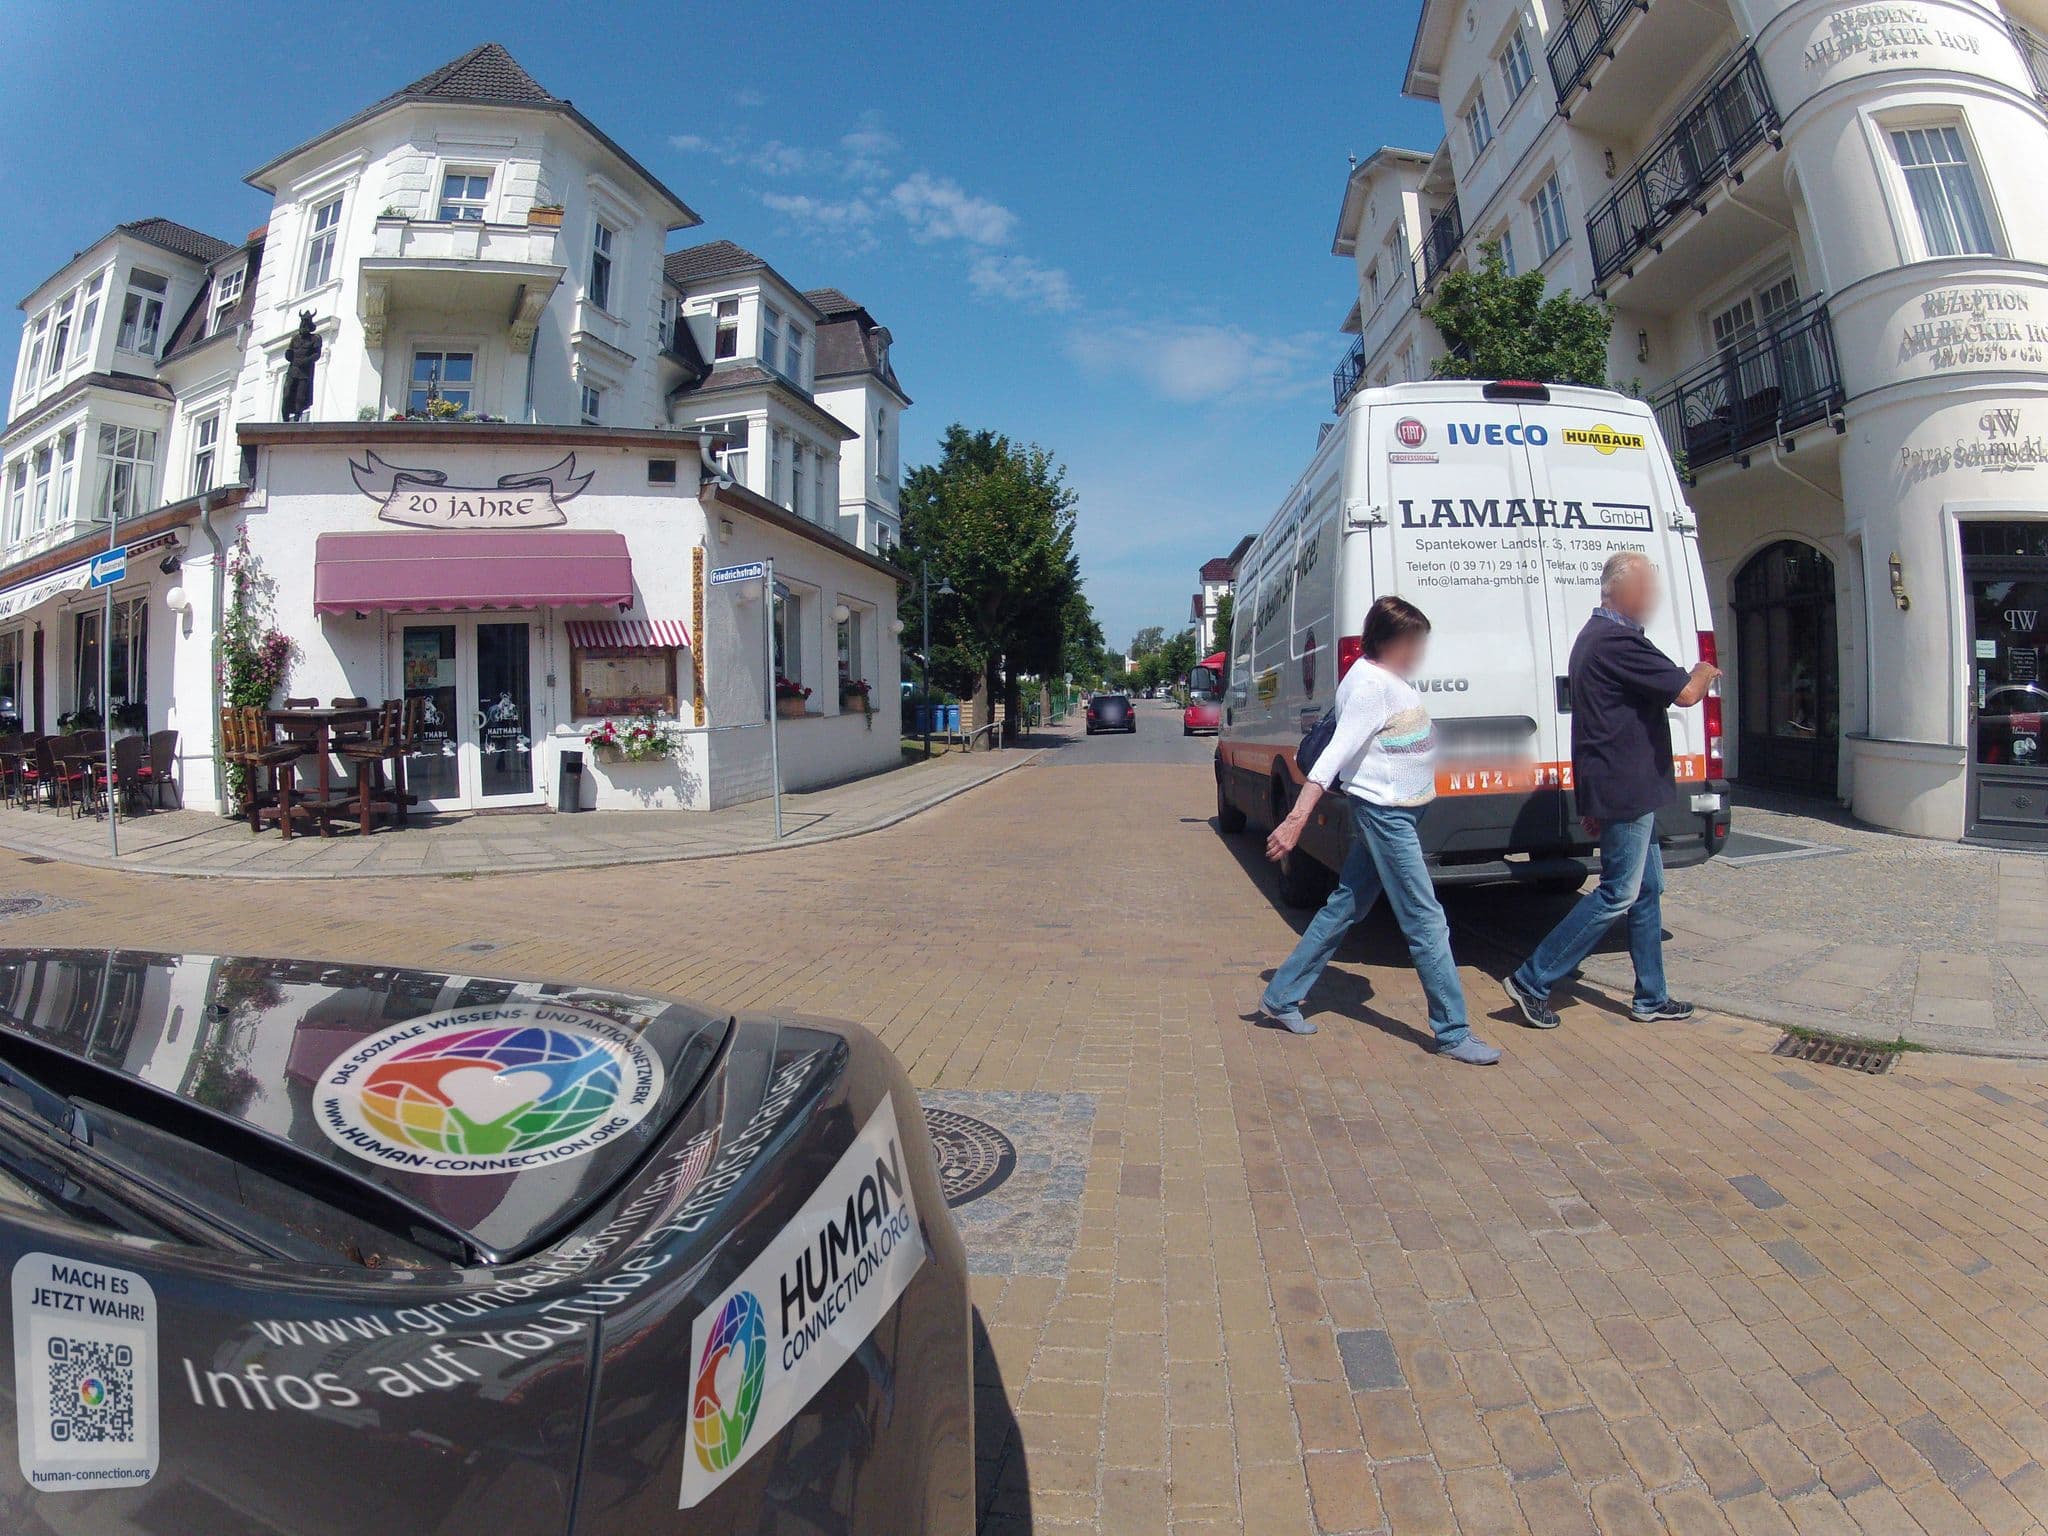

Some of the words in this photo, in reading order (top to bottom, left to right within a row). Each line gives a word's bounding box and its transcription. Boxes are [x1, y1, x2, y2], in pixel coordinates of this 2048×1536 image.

[1402, 425, 1421, 441] FIAT
[1447, 423, 1549, 446] IVECO
[1566, 431, 1642, 448] HUMBAUR
[409, 495, 437, 514] 20
[1399, 499, 1588, 529] LAMAHA
[1599, 510, 1645, 526] GmbH
[1415, 538, 1498, 553] Spantekower
[1570, 539, 1602, 551] 17389
[1606, 540, 1646, 552] Anklam
[712, 564, 762, 582] Friedrichstraße
[1406, 560, 1446, 572] Telefon
[1463, 560, 1477, 571] 39
[1499, 559, 1513, 571] 29
[1516, 559, 1528, 570] 14
[1417, 574, 1540, 588] info@lamaha-gmbh.de
[331, 1061, 359, 1086] DAS
[353, 1025, 427, 1064] SOZIALE
[427, 1009, 529, 1030] WISSENS-
[535, 1009, 580, 1025] UND
[579, 1019, 653, 1106] AKTIONSNETZWERK
[779, 1136, 905, 1339] HUMAN
[51, 1263, 106, 1291] MACH
[111, 1276, 129, 1295] ES
[782, 1203, 911, 1372] CONNECTION.ORG
[31, 1286, 85, 1312] JETZT
[89, 1296, 145, 1322] WAHR!
[183, 1356, 361, 1411] Infos
[366, 1343, 482, 1398] auf
[458, 1248, 674, 1360] YouTube
[32, 1467, 151, 1483] human-connection.org
